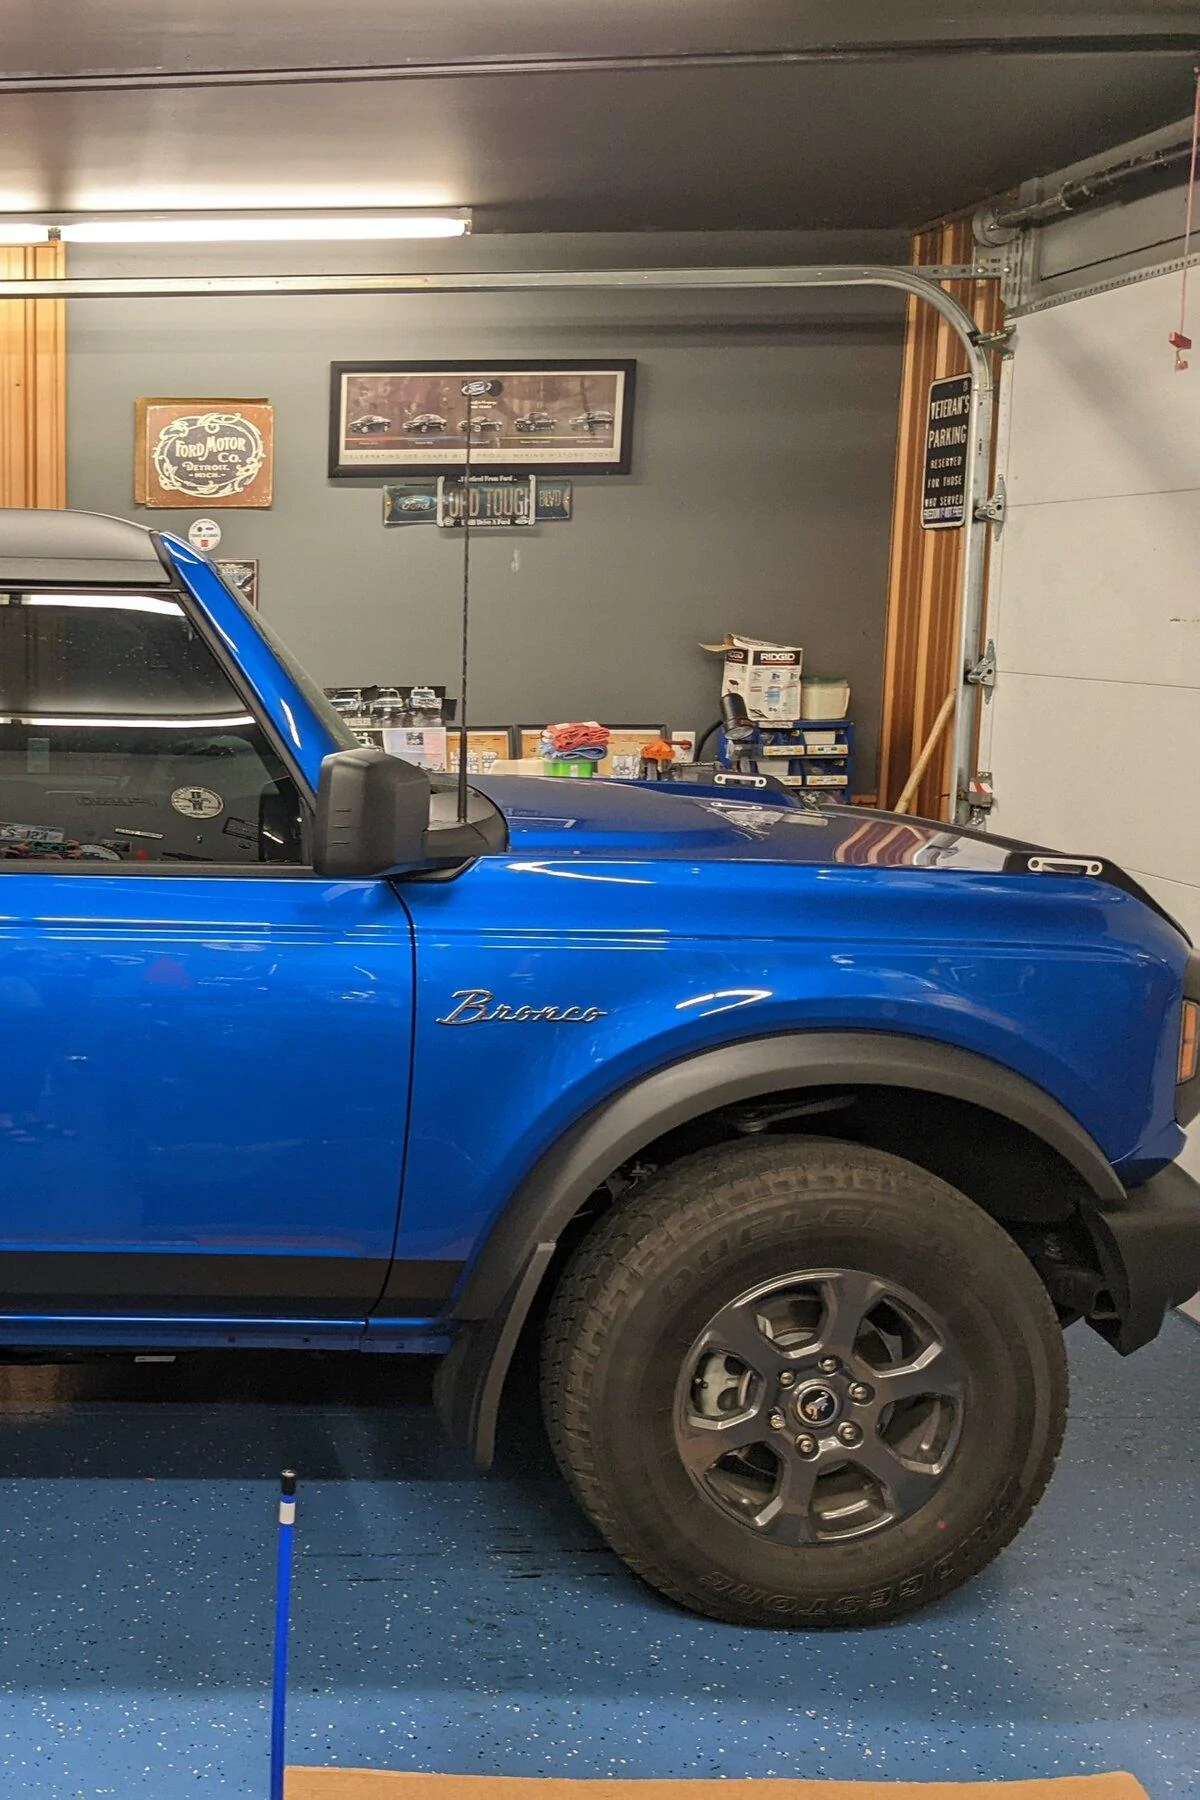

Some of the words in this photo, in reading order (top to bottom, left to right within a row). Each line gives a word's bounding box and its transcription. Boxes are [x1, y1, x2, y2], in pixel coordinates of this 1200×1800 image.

[931, 395, 970, 420] VETERAN'S
[928, 425, 968, 449] PARKING
[199, 436, 246, 460] MOTOR
[930, 456, 962, 469] RESERVED
[927, 478, 940, 489] FOR
[943, 475, 962, 487] THOSE
[940, 494, 964, 506] SERVED
[760, 653, 796, 661] RIDGID
[436, 989, 608, 1025] Bronco
